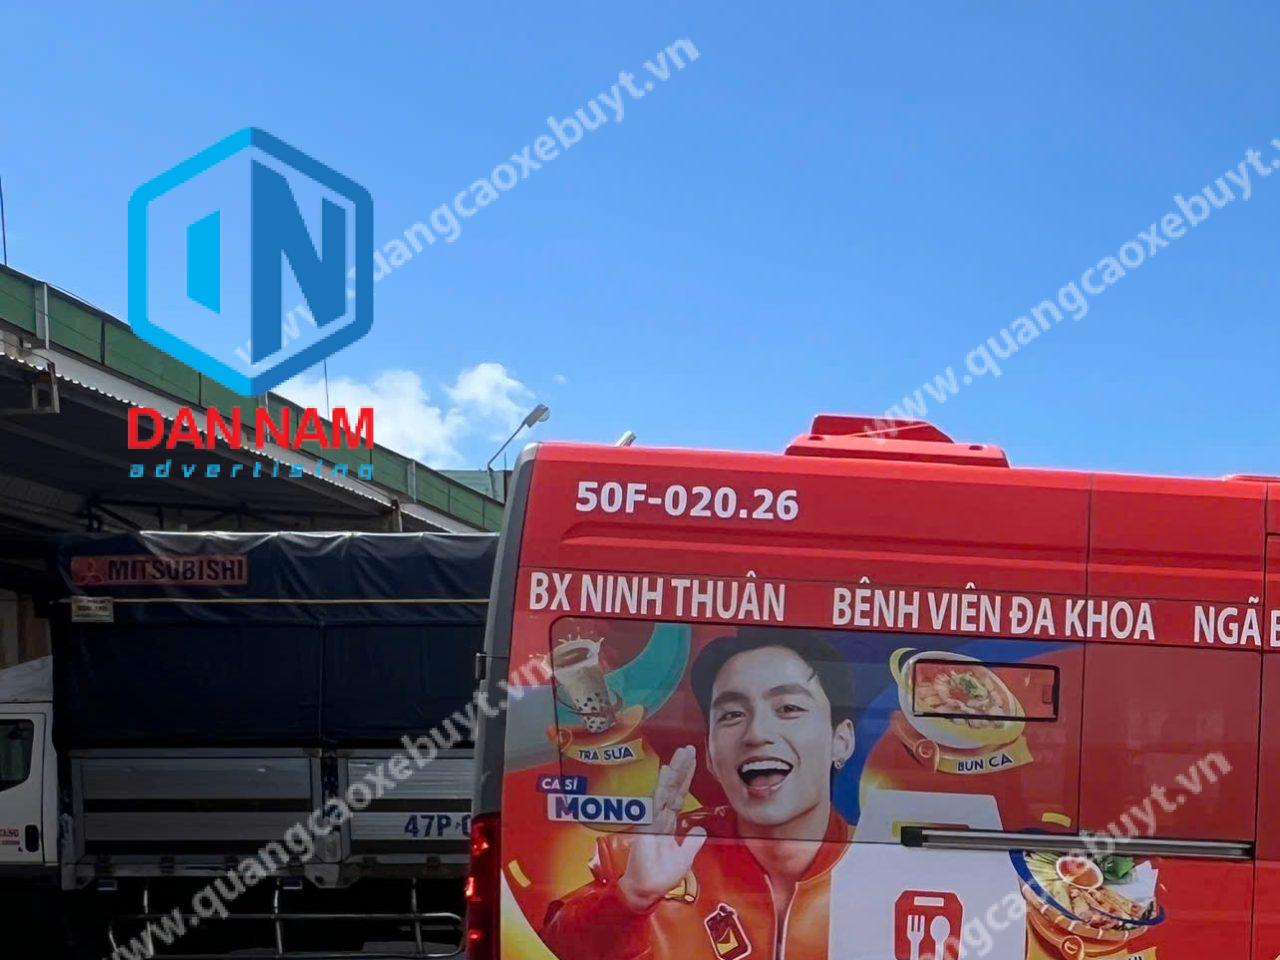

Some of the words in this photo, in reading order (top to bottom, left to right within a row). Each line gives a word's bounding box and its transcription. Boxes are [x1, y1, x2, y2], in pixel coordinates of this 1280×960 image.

[576, 481, 799, 521] 50F-020.26
[108, 559, 243, 581] MITSUBISHI
[529, 571, 572, 611] BX
[580, 574, 663, 616] NINH
[1009, 596, 1056, 636] ĐA
[1064, 598, 1155, 640] KHOA
[1193, 596, 1262, 646] NGÃ
[555, 797, 646, 822] MONO
